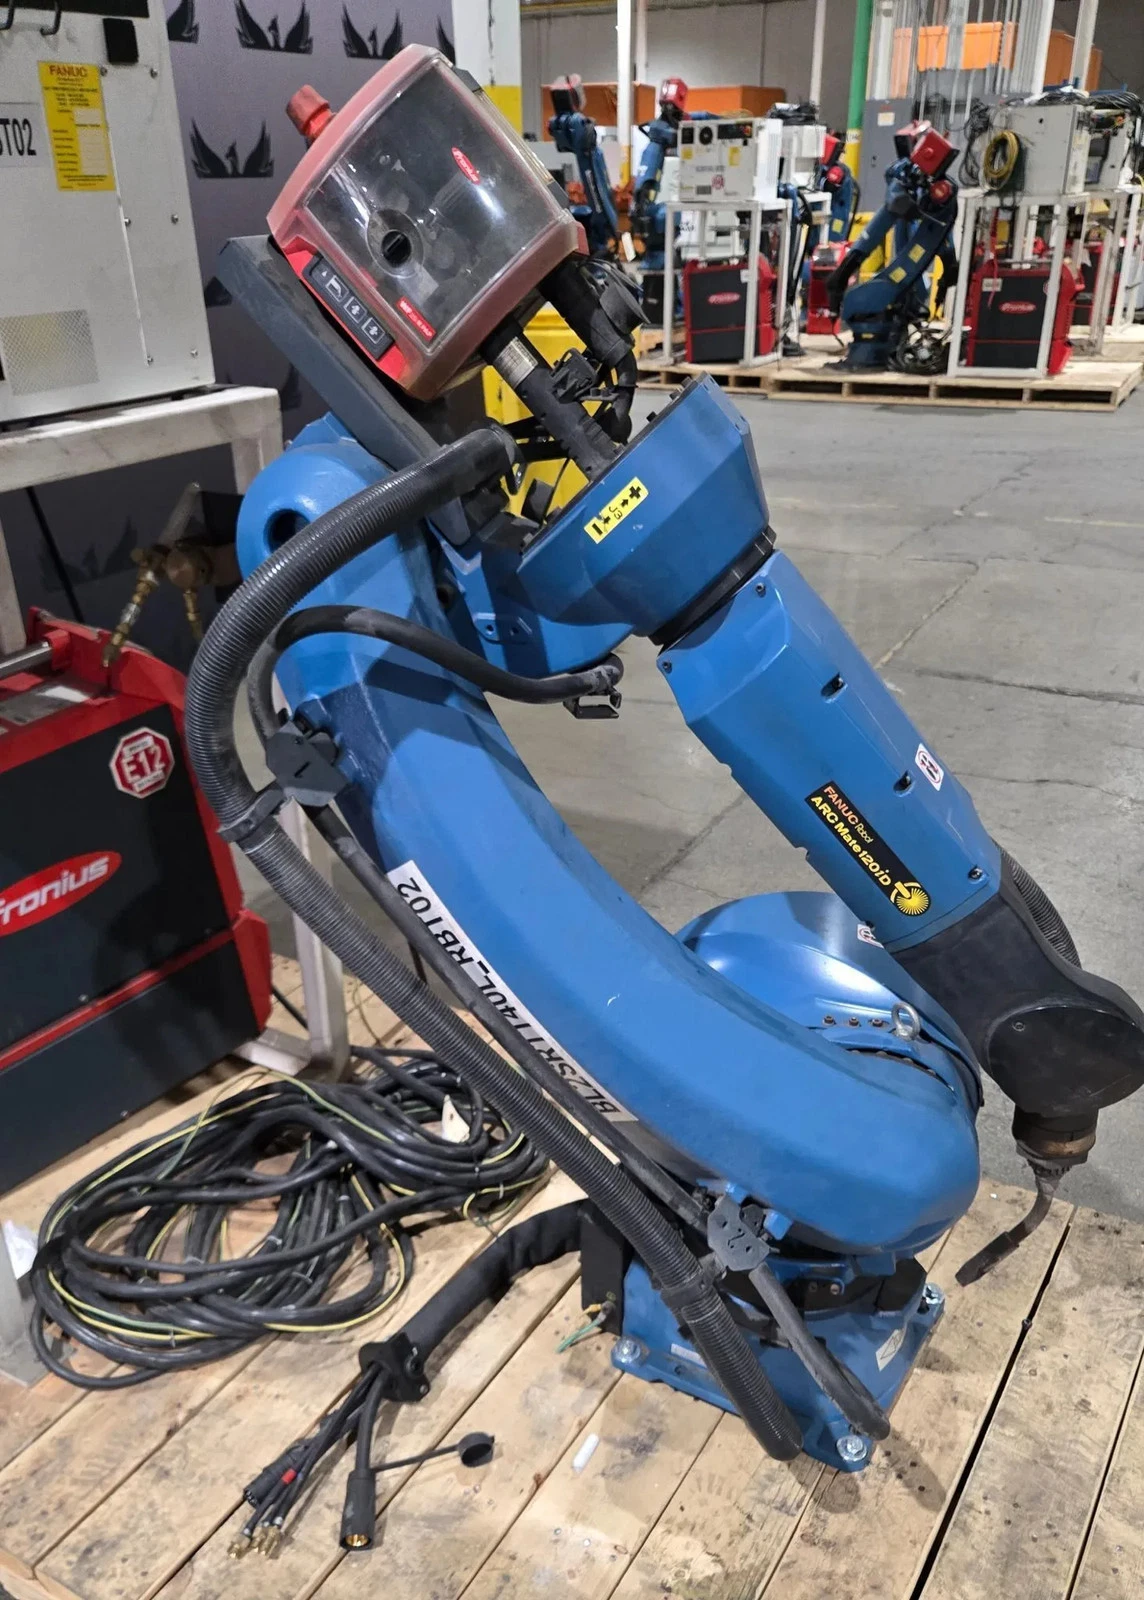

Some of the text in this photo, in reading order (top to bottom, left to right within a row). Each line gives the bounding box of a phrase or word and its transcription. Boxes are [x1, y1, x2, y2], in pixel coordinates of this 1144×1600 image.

[48, 65, 88, 77] FANUC
[0, 118, 37, 156] T02
[609, 506, 623, 520] J3
[121, 745, 166, 783] E12
[811, 796, 839, 824] ARC
[824, 785, 874, 844] FANUC Robot
